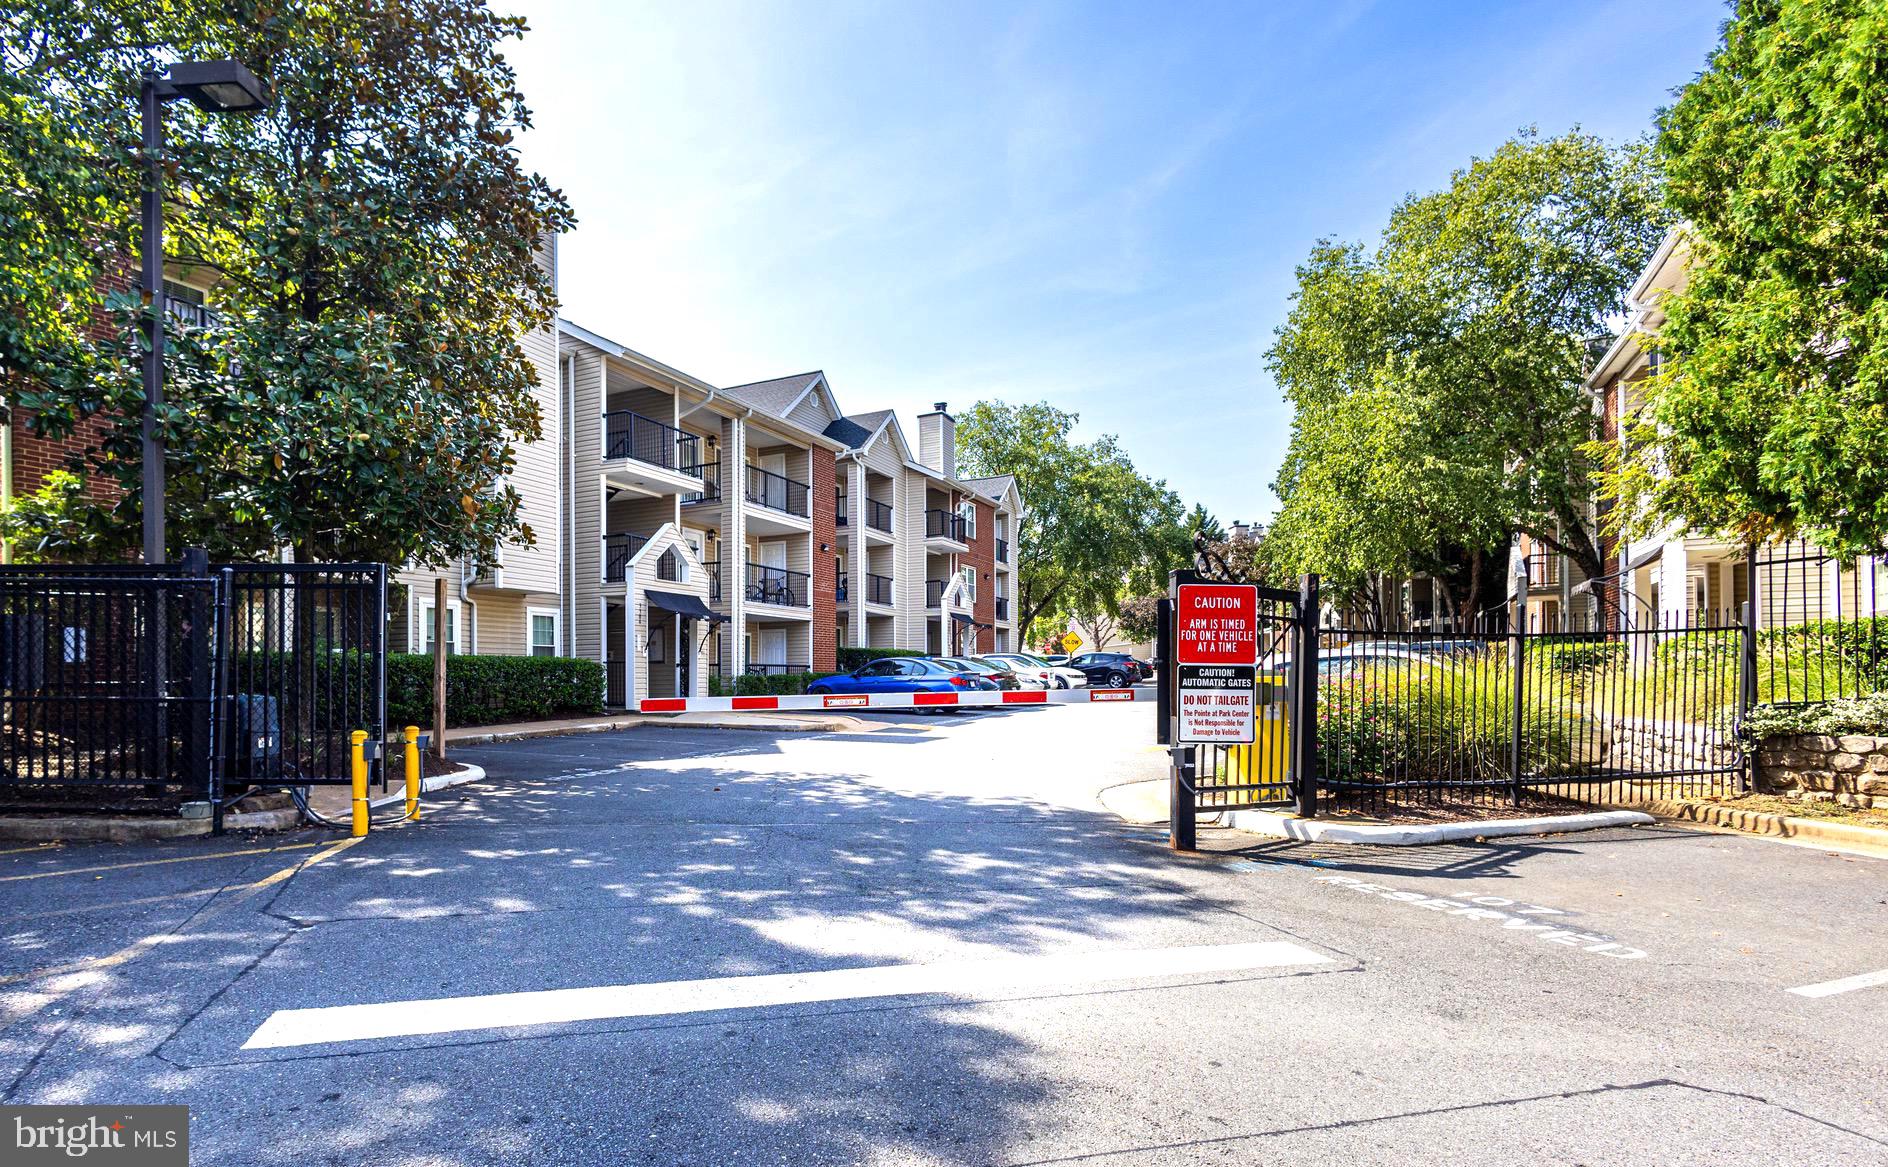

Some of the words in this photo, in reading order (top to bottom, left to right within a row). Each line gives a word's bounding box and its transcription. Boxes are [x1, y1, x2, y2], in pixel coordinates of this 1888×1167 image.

[1195, 597, 1241, 608] CAUTION
[1190, 619, 1207, 629] ARM
[1210, 619, 1218, 629] IS
[1221, 620, 1245, 629] TIMED
[1181, 630, 1197, 641] FOR
[1200, 631, 1216, 641] ONE
[1219, 631, 1253, 641] VEHICLE
[1197, 642, 1207, 652] AT
[1210, 642, 1215, 652] A
[1218, 642, 1237, 653] TIME
[1199, 668, 1235, 677] CAUTION!
[1182, 678, 1225, 687] AUTOMATIC
[1228, 678, 1251, 687] GATES
[1184, 695, 1194, 705] DO
[1197, 695, 1212, 705] NOT
[1214, 696, 1249, 705] TAILGATE
[1205, 719, 1235, 727] Responsible
[1312, 875, 1648, 959] RESERVED
